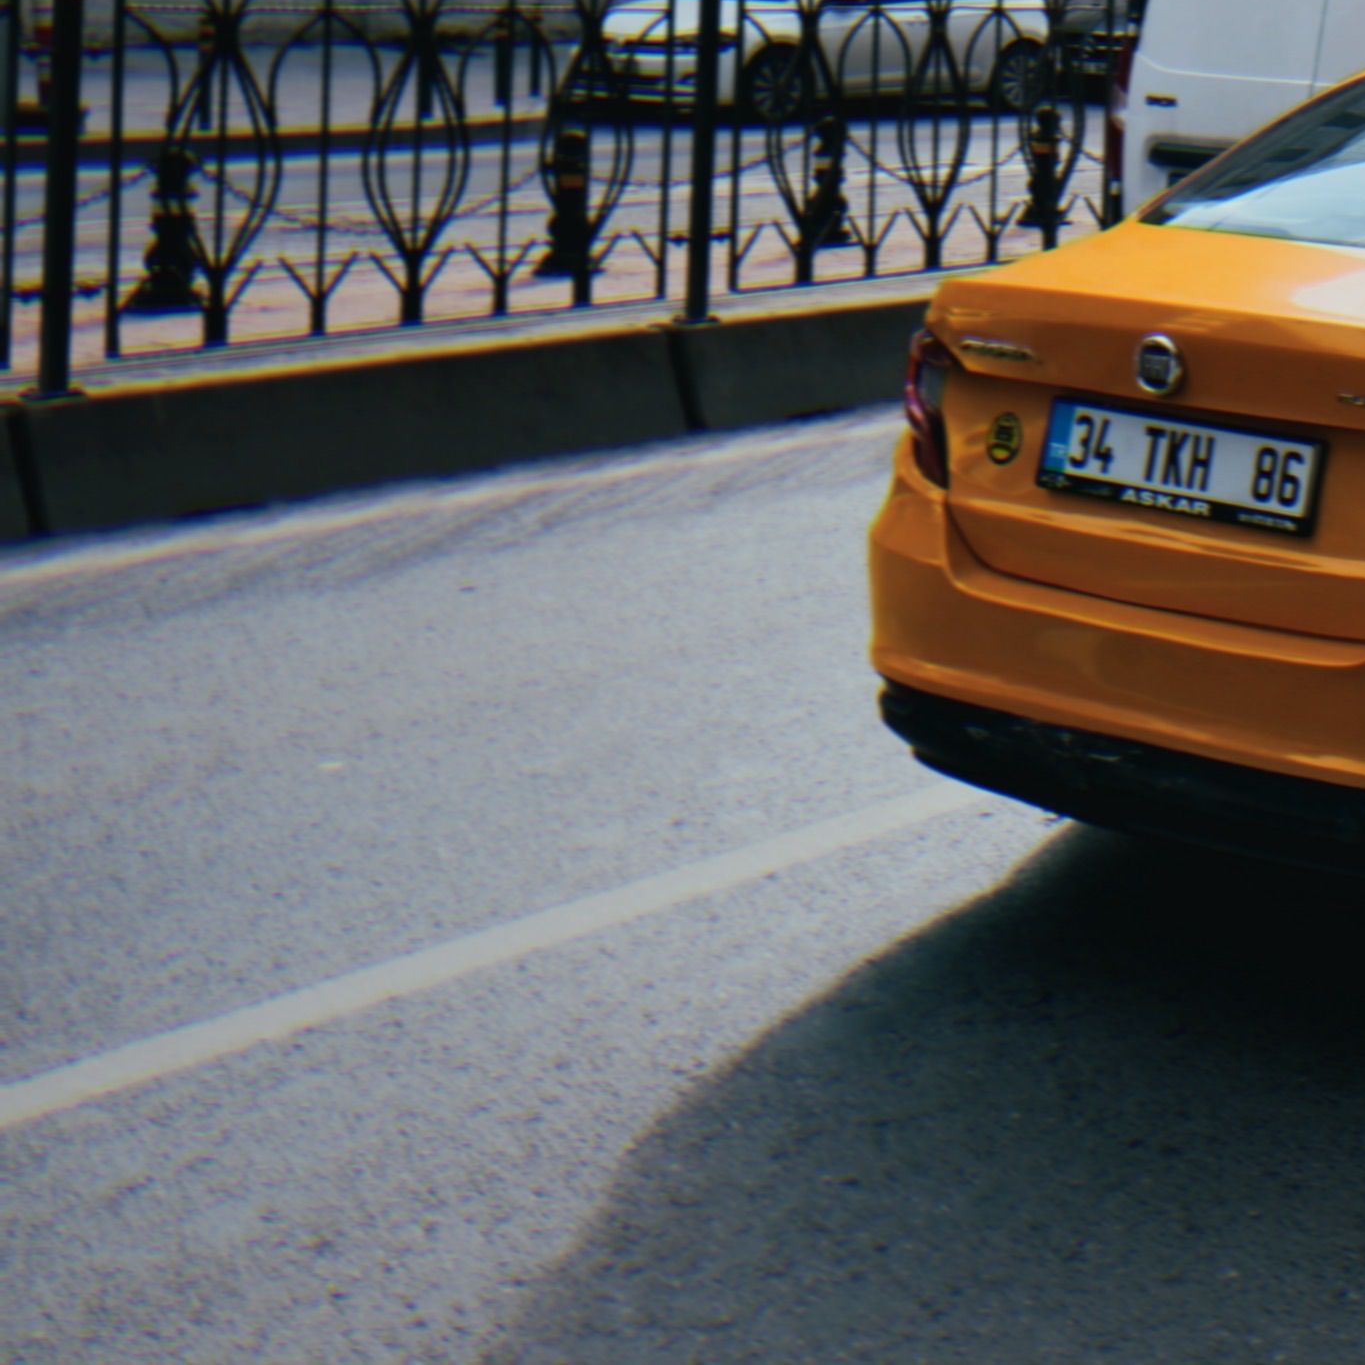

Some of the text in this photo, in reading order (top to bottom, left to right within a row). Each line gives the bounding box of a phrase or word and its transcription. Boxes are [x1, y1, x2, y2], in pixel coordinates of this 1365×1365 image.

[1067, 414, 1114, 475] 34
[1143, 425, 1216, 492] TKH
[1251, 446, 1306, 509] 86
[1119, 487, 1212, 518] ASKAR
